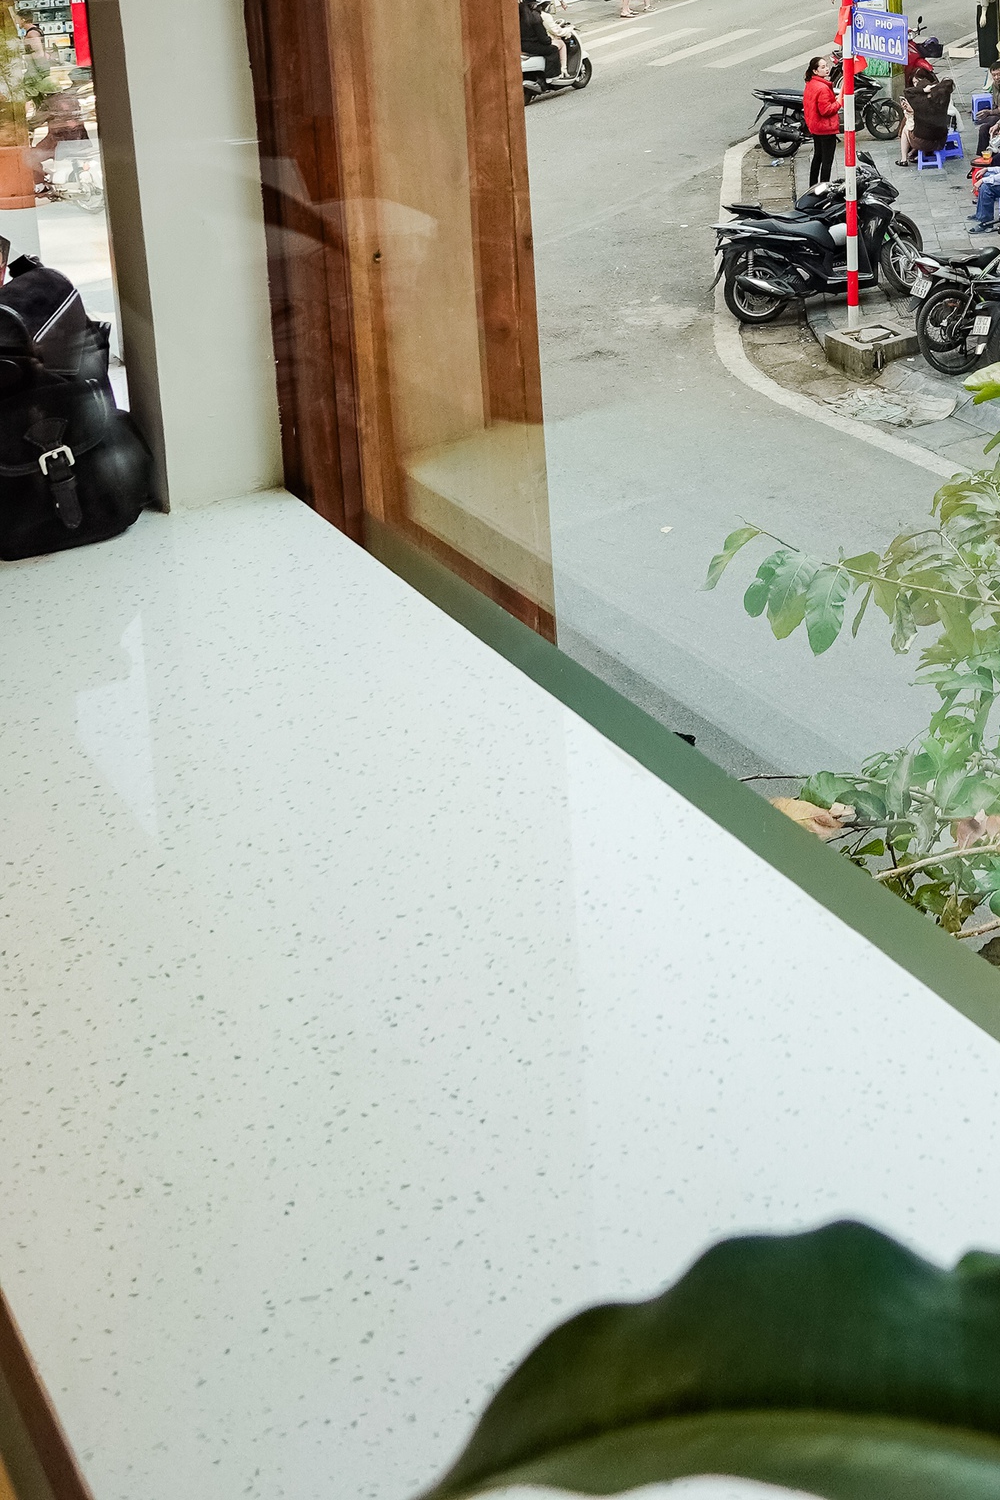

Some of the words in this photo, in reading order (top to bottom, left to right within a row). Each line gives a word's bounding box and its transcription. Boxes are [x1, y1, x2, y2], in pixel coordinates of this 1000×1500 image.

[875, 18, 893, 30] PHỐ
[856, 30, 886, 53] HÀNG
[887, 35, 902, 56] CÁ
